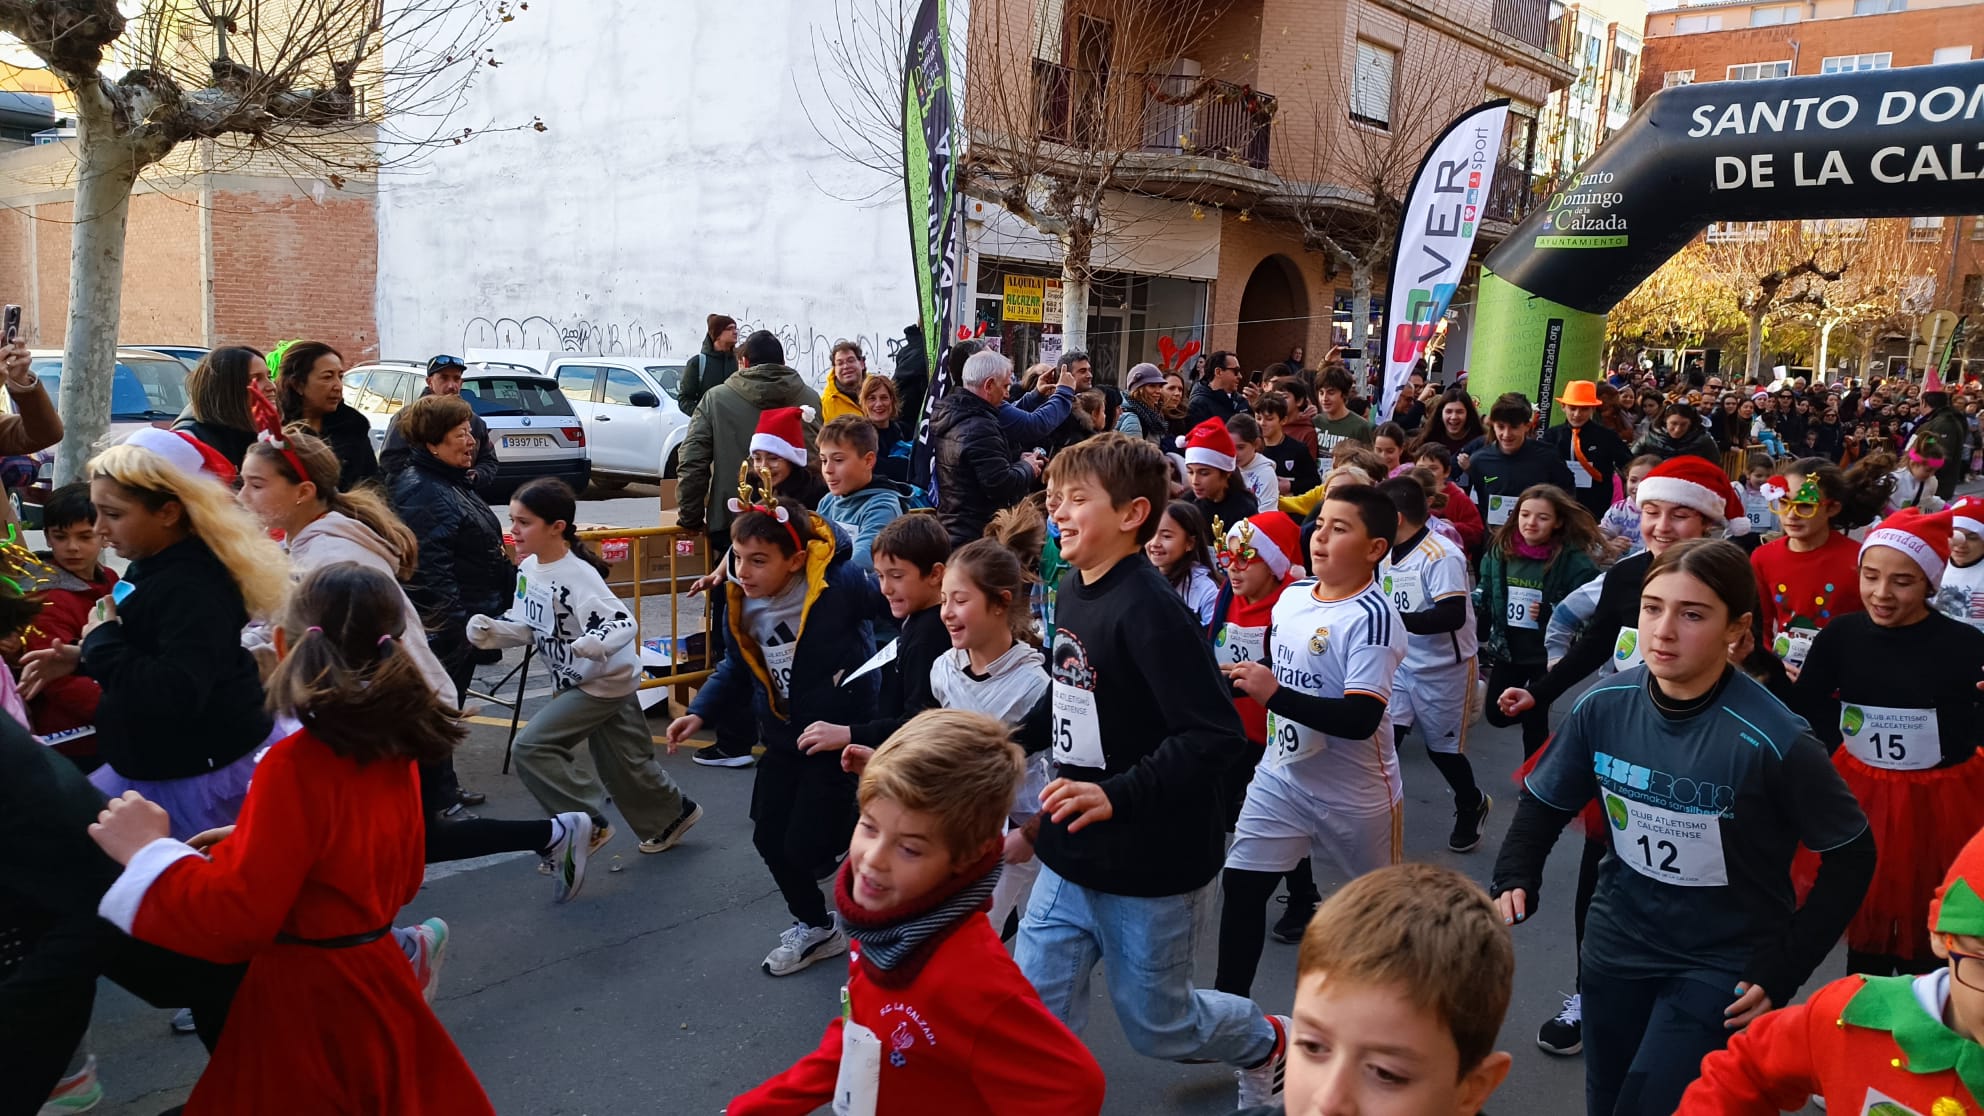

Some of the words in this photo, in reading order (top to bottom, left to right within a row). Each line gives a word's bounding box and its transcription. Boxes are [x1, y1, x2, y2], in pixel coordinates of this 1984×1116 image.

[1688, 95, 1860, 138] SANTO
[1471, 127, 1489, 170] sport
[1715, 154, 1775, 190] DE
[1793, 150, 1854, 187] LA
[1870, 141, 1984, 184] CAL
[1568, 170, 1614, 192] Santo
[1546, 189, 1623, 212] Domingo
[1574, 207, 1583, 215] de
[1584, 206, 1591, 214] la
[1554, 208, 1628, 231] Calzada
[1540, 237, 1623, 247] AYUNTAMIENTO
[1008, 276, 1041, 289] ALQUILA
[509, 437, 531, 447] 9397
[1875, 529, 1926, 555] Navidad
[524, 597, 544, 623] 107
[1394, 591, 1410, 610] 98
[1507, 602, 1525, 621] 39
[1230, 643, 1250, 664] 38
[1277, 644, 1295, 665] Fly
[770, 668, 791, 690] 89
[1866, 713, 1884, 721] CLUB
[1886, 714, 1928, 722] ATLETISMO
[1870, 722, 1924, 730] CALCEATENSE
[1278, 723, 1299, 757] 99
[1869, 732, 1906, 761] 15
[1631, 808, 1654, 822] CLUB
[1655, 815, 1708, 831] ATLETISMO
[1637, 820, 1702, 840] CALCEATENSE
[1636, 834, 1681, 875] 12
